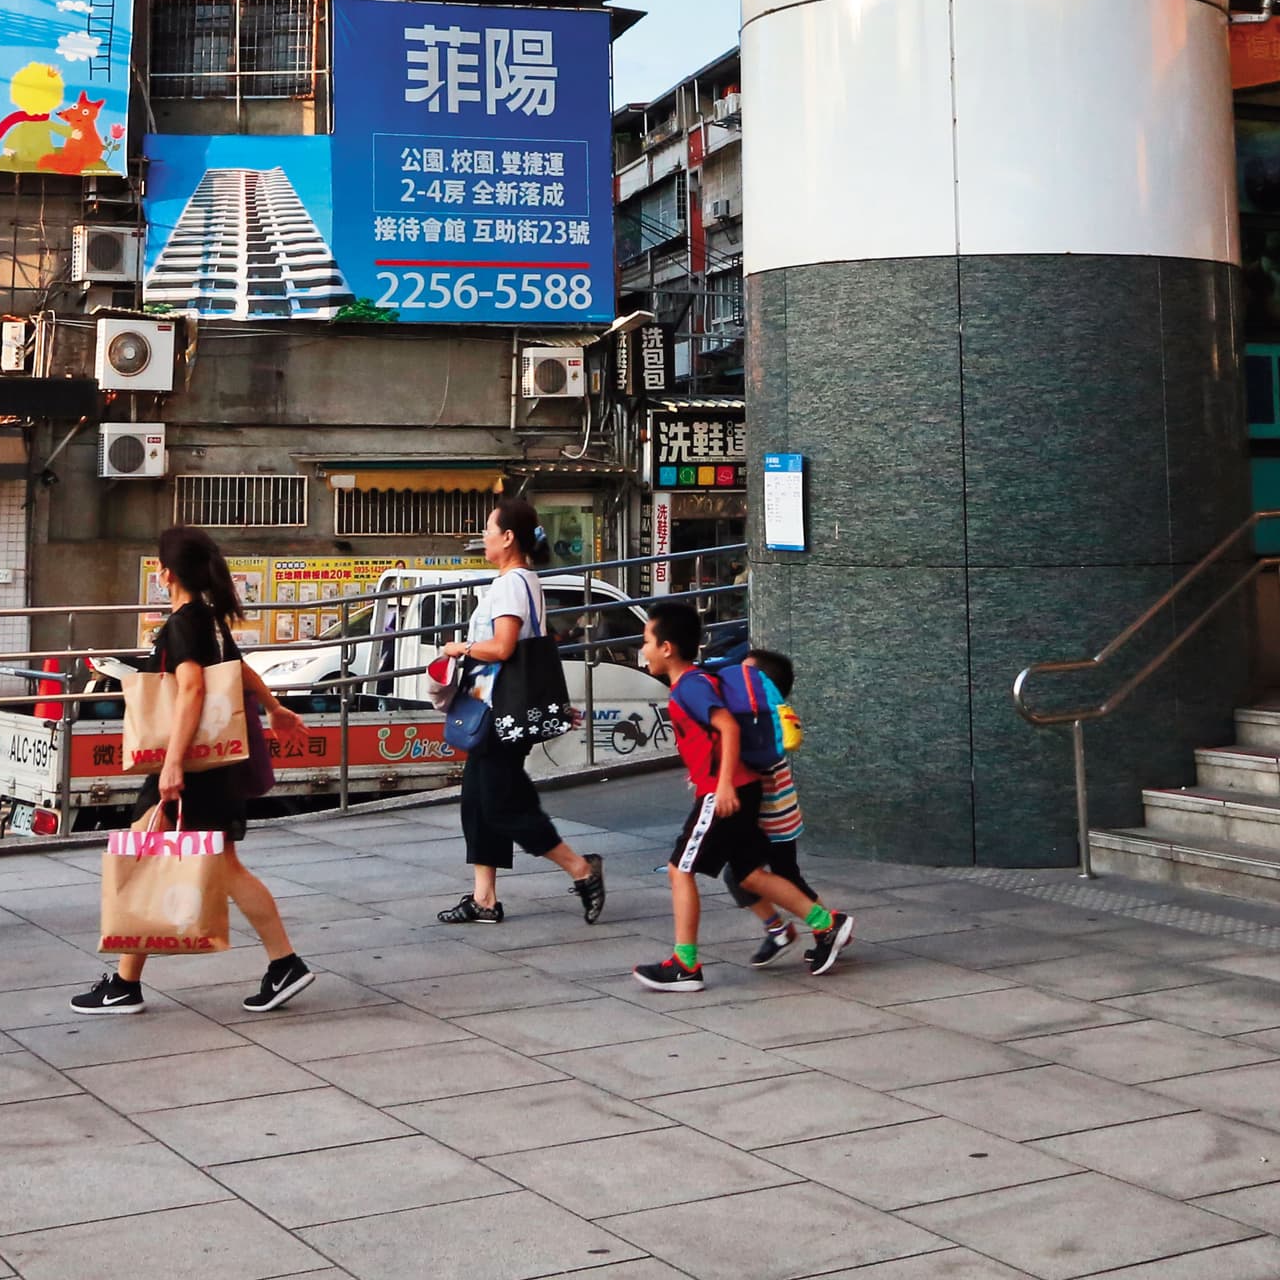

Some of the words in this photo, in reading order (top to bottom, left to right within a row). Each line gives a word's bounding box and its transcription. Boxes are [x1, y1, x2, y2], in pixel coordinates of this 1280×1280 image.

[404, 24, 558, 116] 菲陽
[400, 178, 466, 206] 2-4房
[472, 181, 565, 208] 全新落成
[374, 216, 467, 244] 接待會館
[472, 218, 591, 246] 互助街23號
[374, 271, 592, 310] 2256-5588
[641, 327, 665, 391] 洗包包
[656, 503, 668, 582] 洗鞋子包
[9, 734, 51, 768] ALC-159
[215, 739, 243, 757] 1/2
[145, 936, 180, 949] AND
